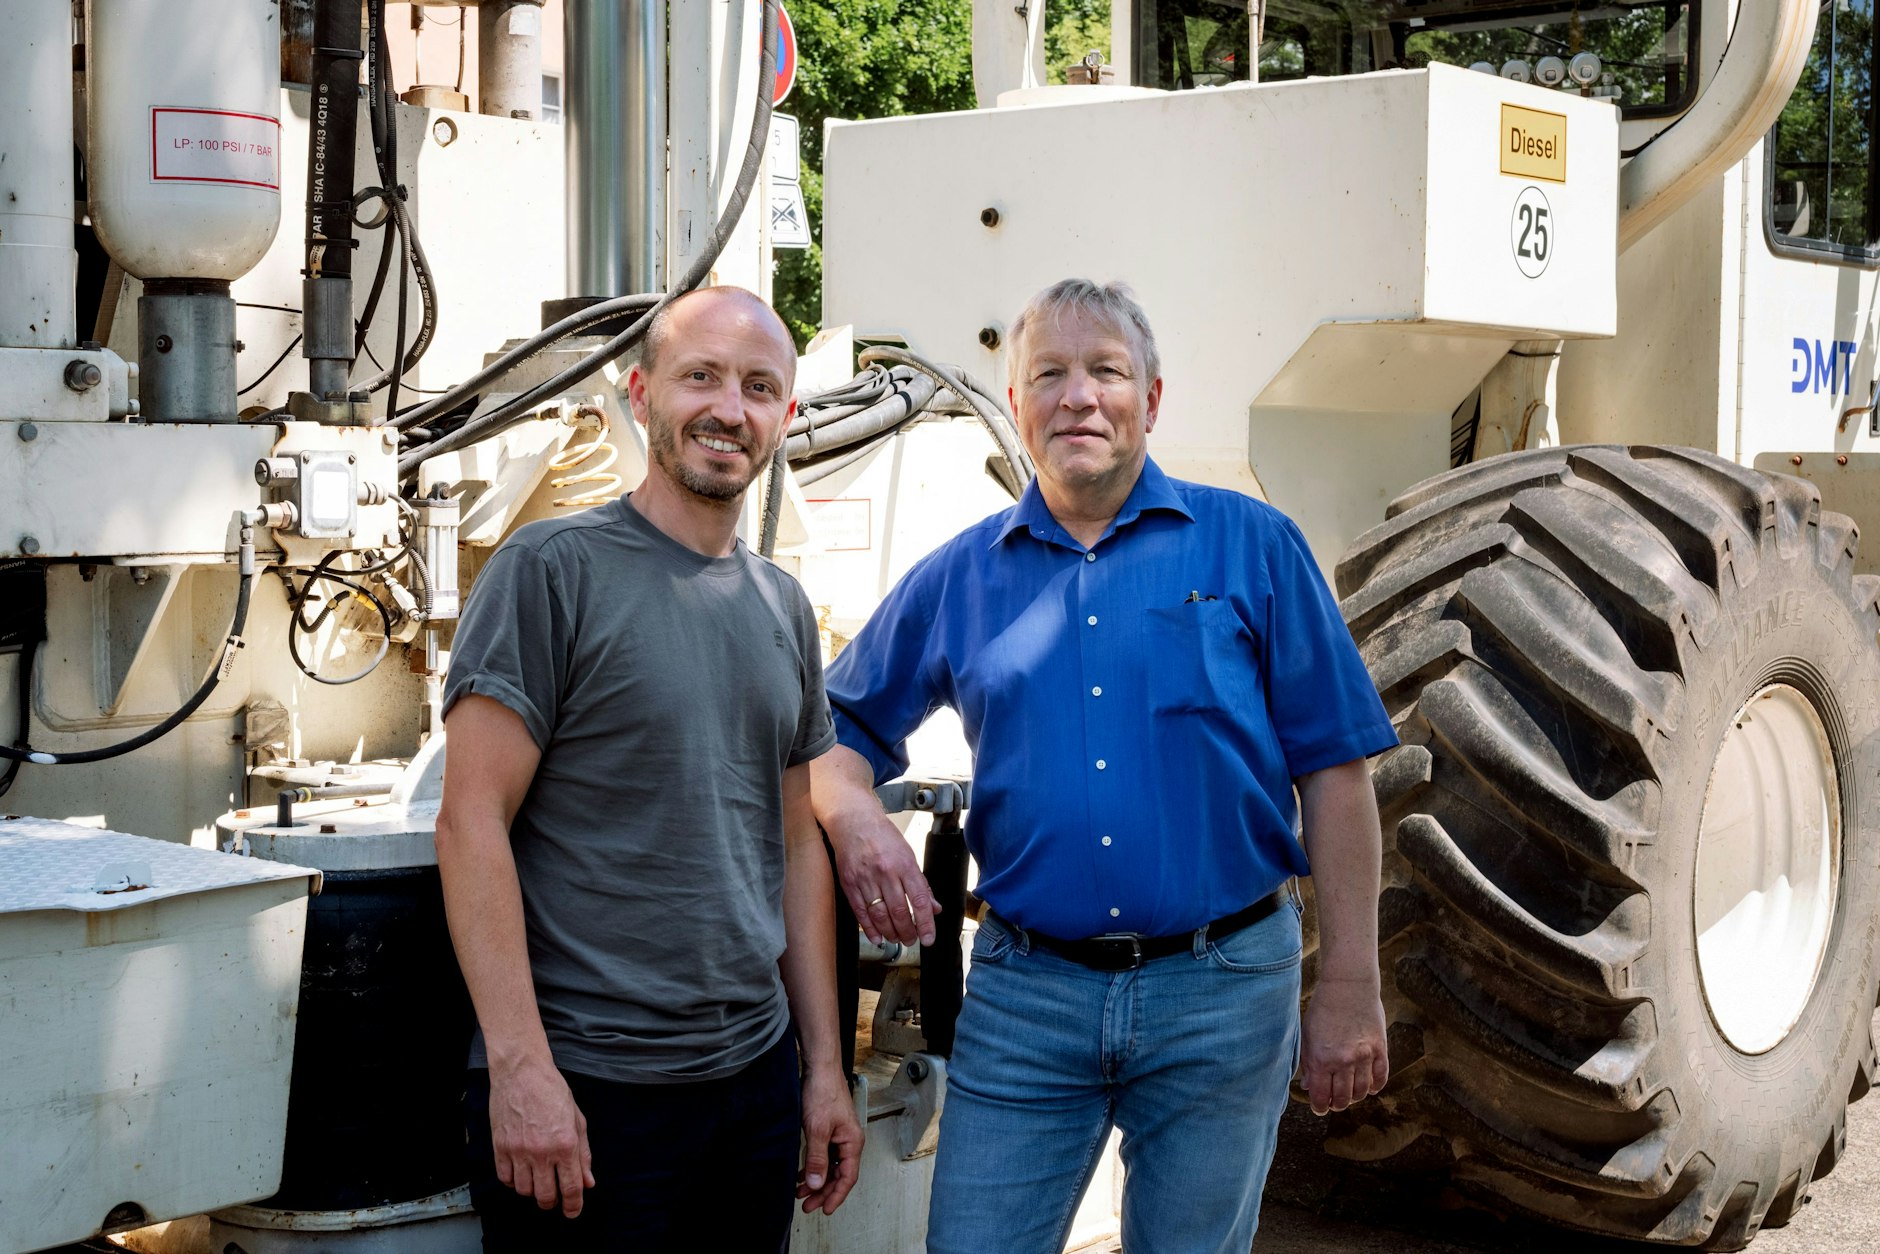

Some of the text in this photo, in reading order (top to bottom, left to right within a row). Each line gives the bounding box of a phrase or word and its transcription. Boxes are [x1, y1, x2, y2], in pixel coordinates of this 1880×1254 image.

[318, 97, 328, 127] 4Q18
[174, 138, 194, 150] LP:
[198, 139, 219, 151] 100
[222, 141, 241, 153] PSI
[249, 144, 254, 154] 7
[256, 145, 273, 157] BAR
[315, 129, 327, 175] IC-84/43
[1511, 127, 1557, 160] Diesel
[1517, 203, 1548, 262] 25
[1791, 337, 1857, 396] DMT
[1709, 590, 1807, 722] ALLIANCE
